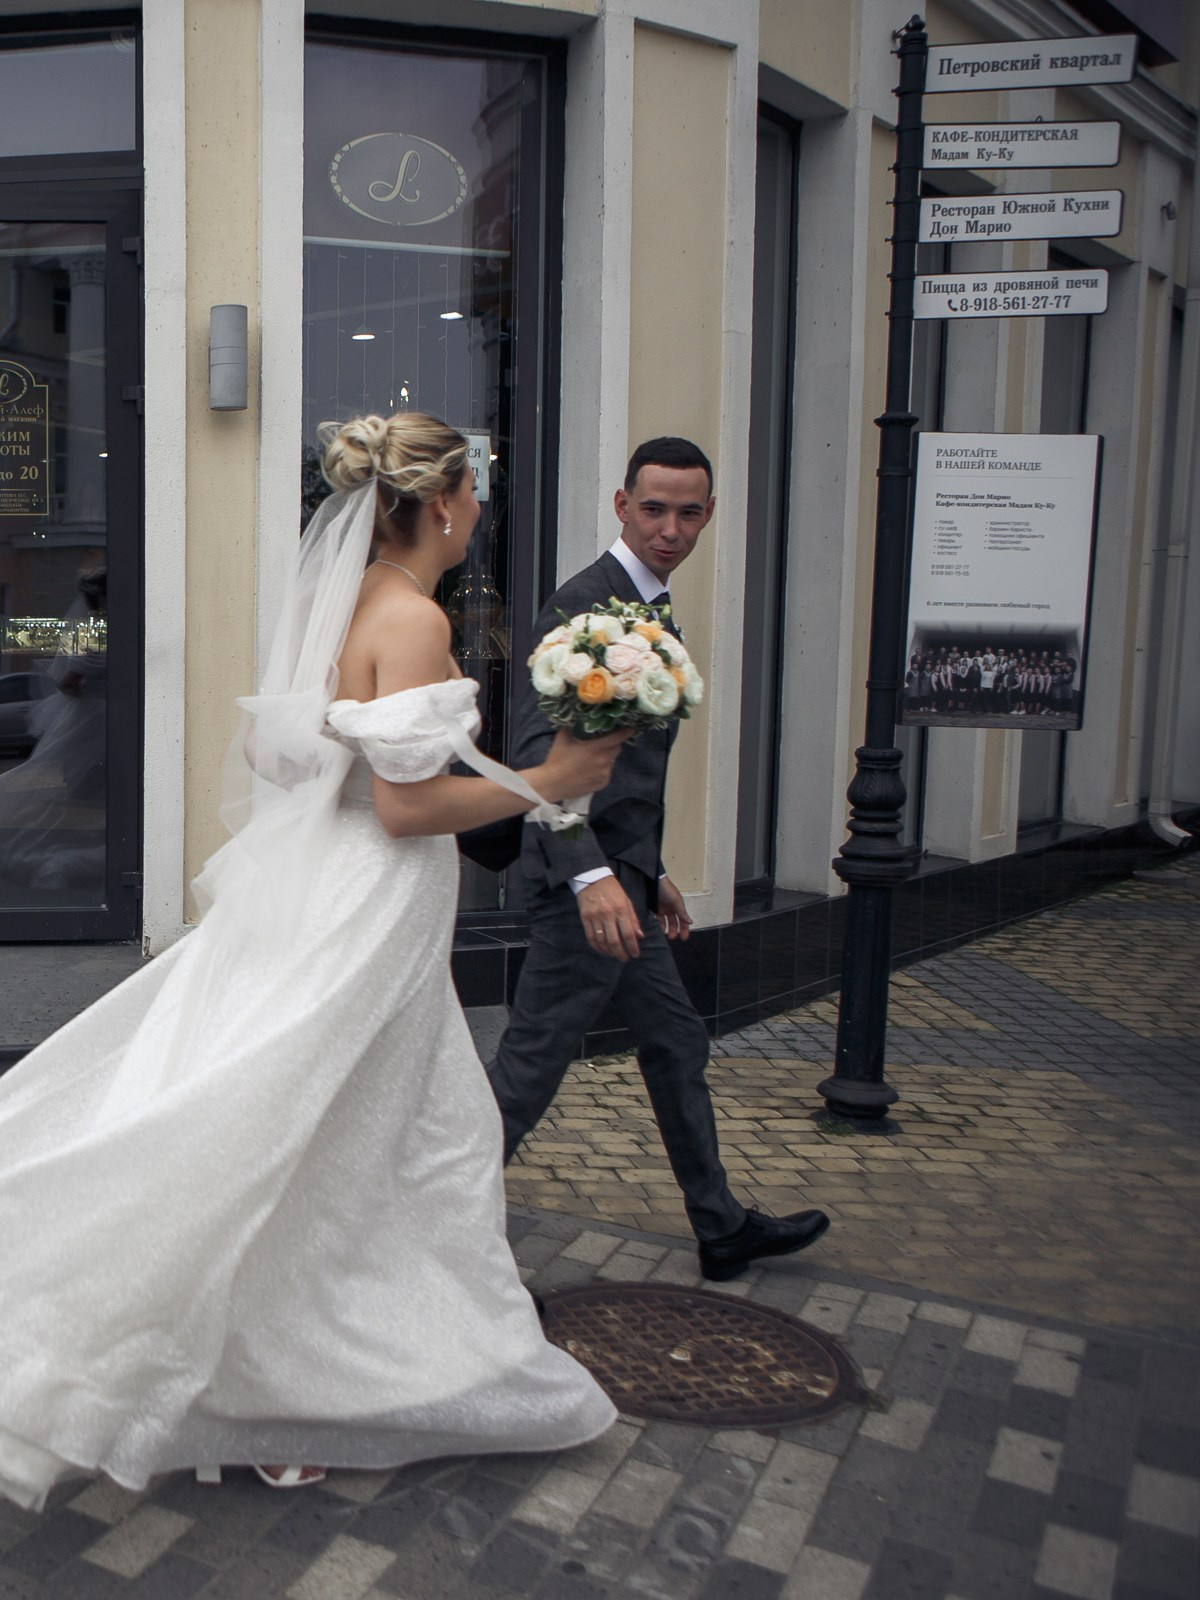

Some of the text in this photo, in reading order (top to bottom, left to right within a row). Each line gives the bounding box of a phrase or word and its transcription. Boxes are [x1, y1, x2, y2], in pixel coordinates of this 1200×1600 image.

[938, 53, 1122, 76] Петровский квартал
[931, 129, 1079, 144] КАФЕ-КОНДИТЕРСКАЯ
[931, 147, 1014, 161] Мадам Ку-Ку
[931, 198, 1109, 218] Ресторан Южной Кухни
[930, 221, 1011, 237] Дон Марио
[921, 277, 1098, 295] Пицца из дровяной печи
[960, 295, 1071, 312] 8-918-561-27-77
[936, 448, 998, 458] РАБОТАЙТЕ
[20, 466, 38, 480] 20
[936, 460, 1041, 471] В НАШЕЙ КОМАНДЕ
[986, 493, 1011, 501] Марио
